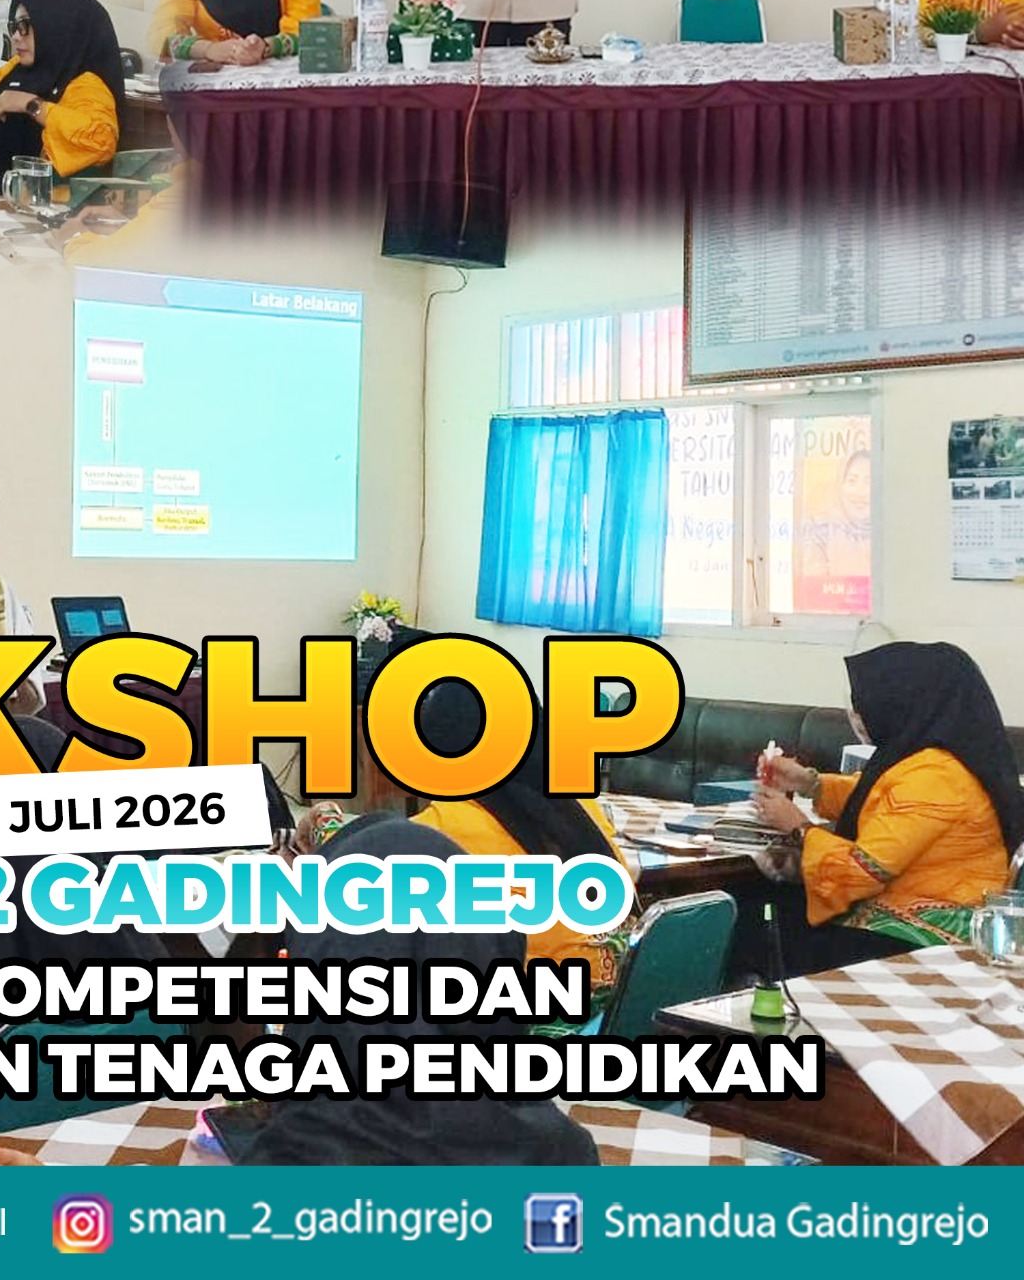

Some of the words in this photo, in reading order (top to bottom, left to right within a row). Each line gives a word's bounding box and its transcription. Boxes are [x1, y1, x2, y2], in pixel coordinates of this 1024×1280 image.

[252, 291, 289, 308] Latar
[294, 294, 357, 317] Belakang
[772, 430, 866, 457] AMPUNG
[681, 471, 730, 497] TAHU
